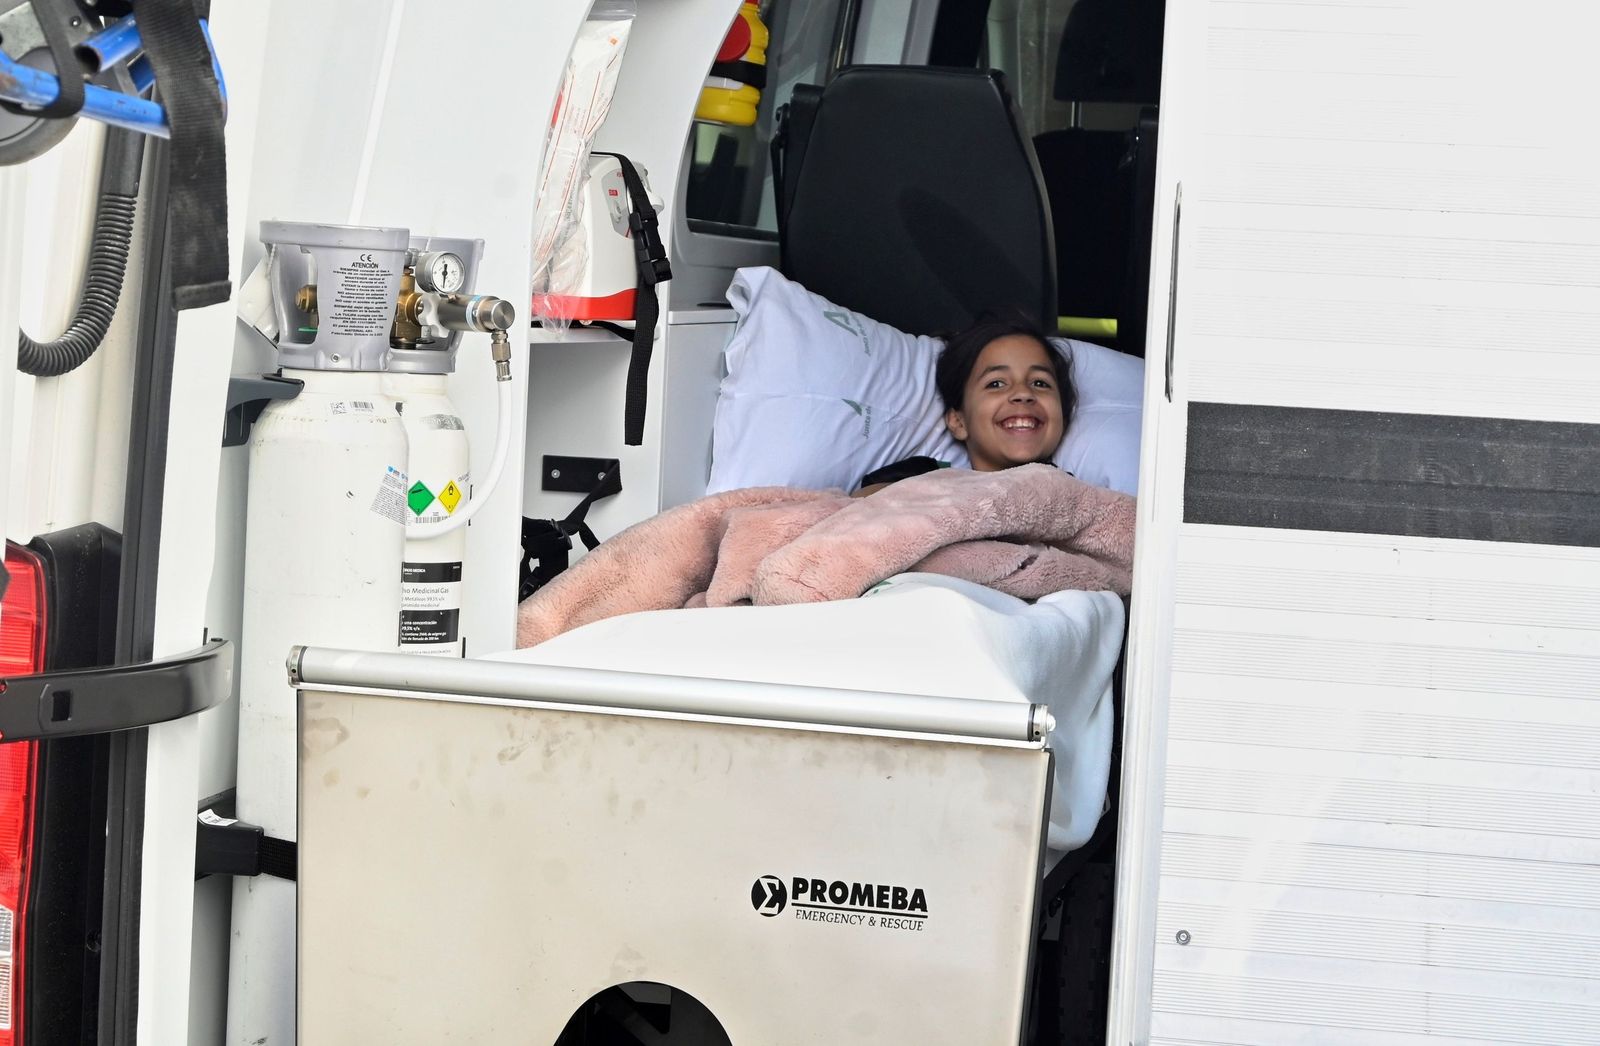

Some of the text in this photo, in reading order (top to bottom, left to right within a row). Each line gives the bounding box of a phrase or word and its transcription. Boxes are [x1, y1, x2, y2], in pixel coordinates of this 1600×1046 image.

[792, 876, 928, 912] PROMEBA
[796, 910, 924, 931] EMERGENCY & RESCUE
